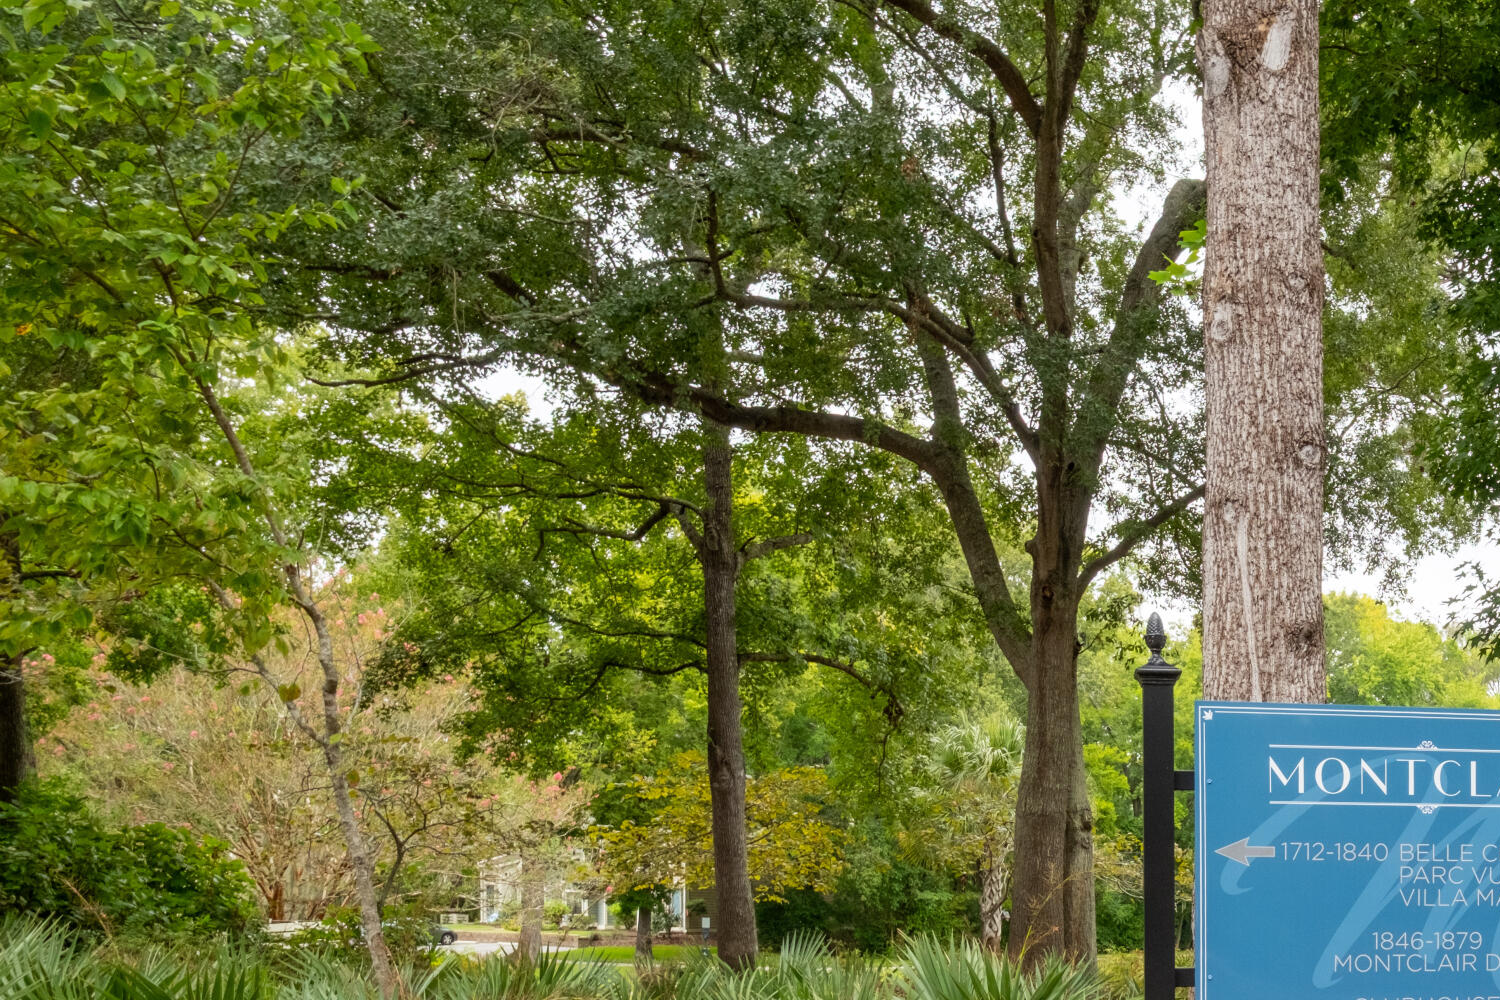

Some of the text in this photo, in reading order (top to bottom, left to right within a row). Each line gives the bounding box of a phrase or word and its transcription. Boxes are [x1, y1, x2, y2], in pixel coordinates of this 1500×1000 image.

[1280, 842, 1388, 862] 1712-1840
[1400, 843, 1473, 862] BELLE
[1399, 866, 1464, 885] PARC
[1399, 889, 1468, 907] VILLA
[1372, 932, 1482, 950] 1846-1879
[1334, 954, 1477, 973] MONTCLAIR
